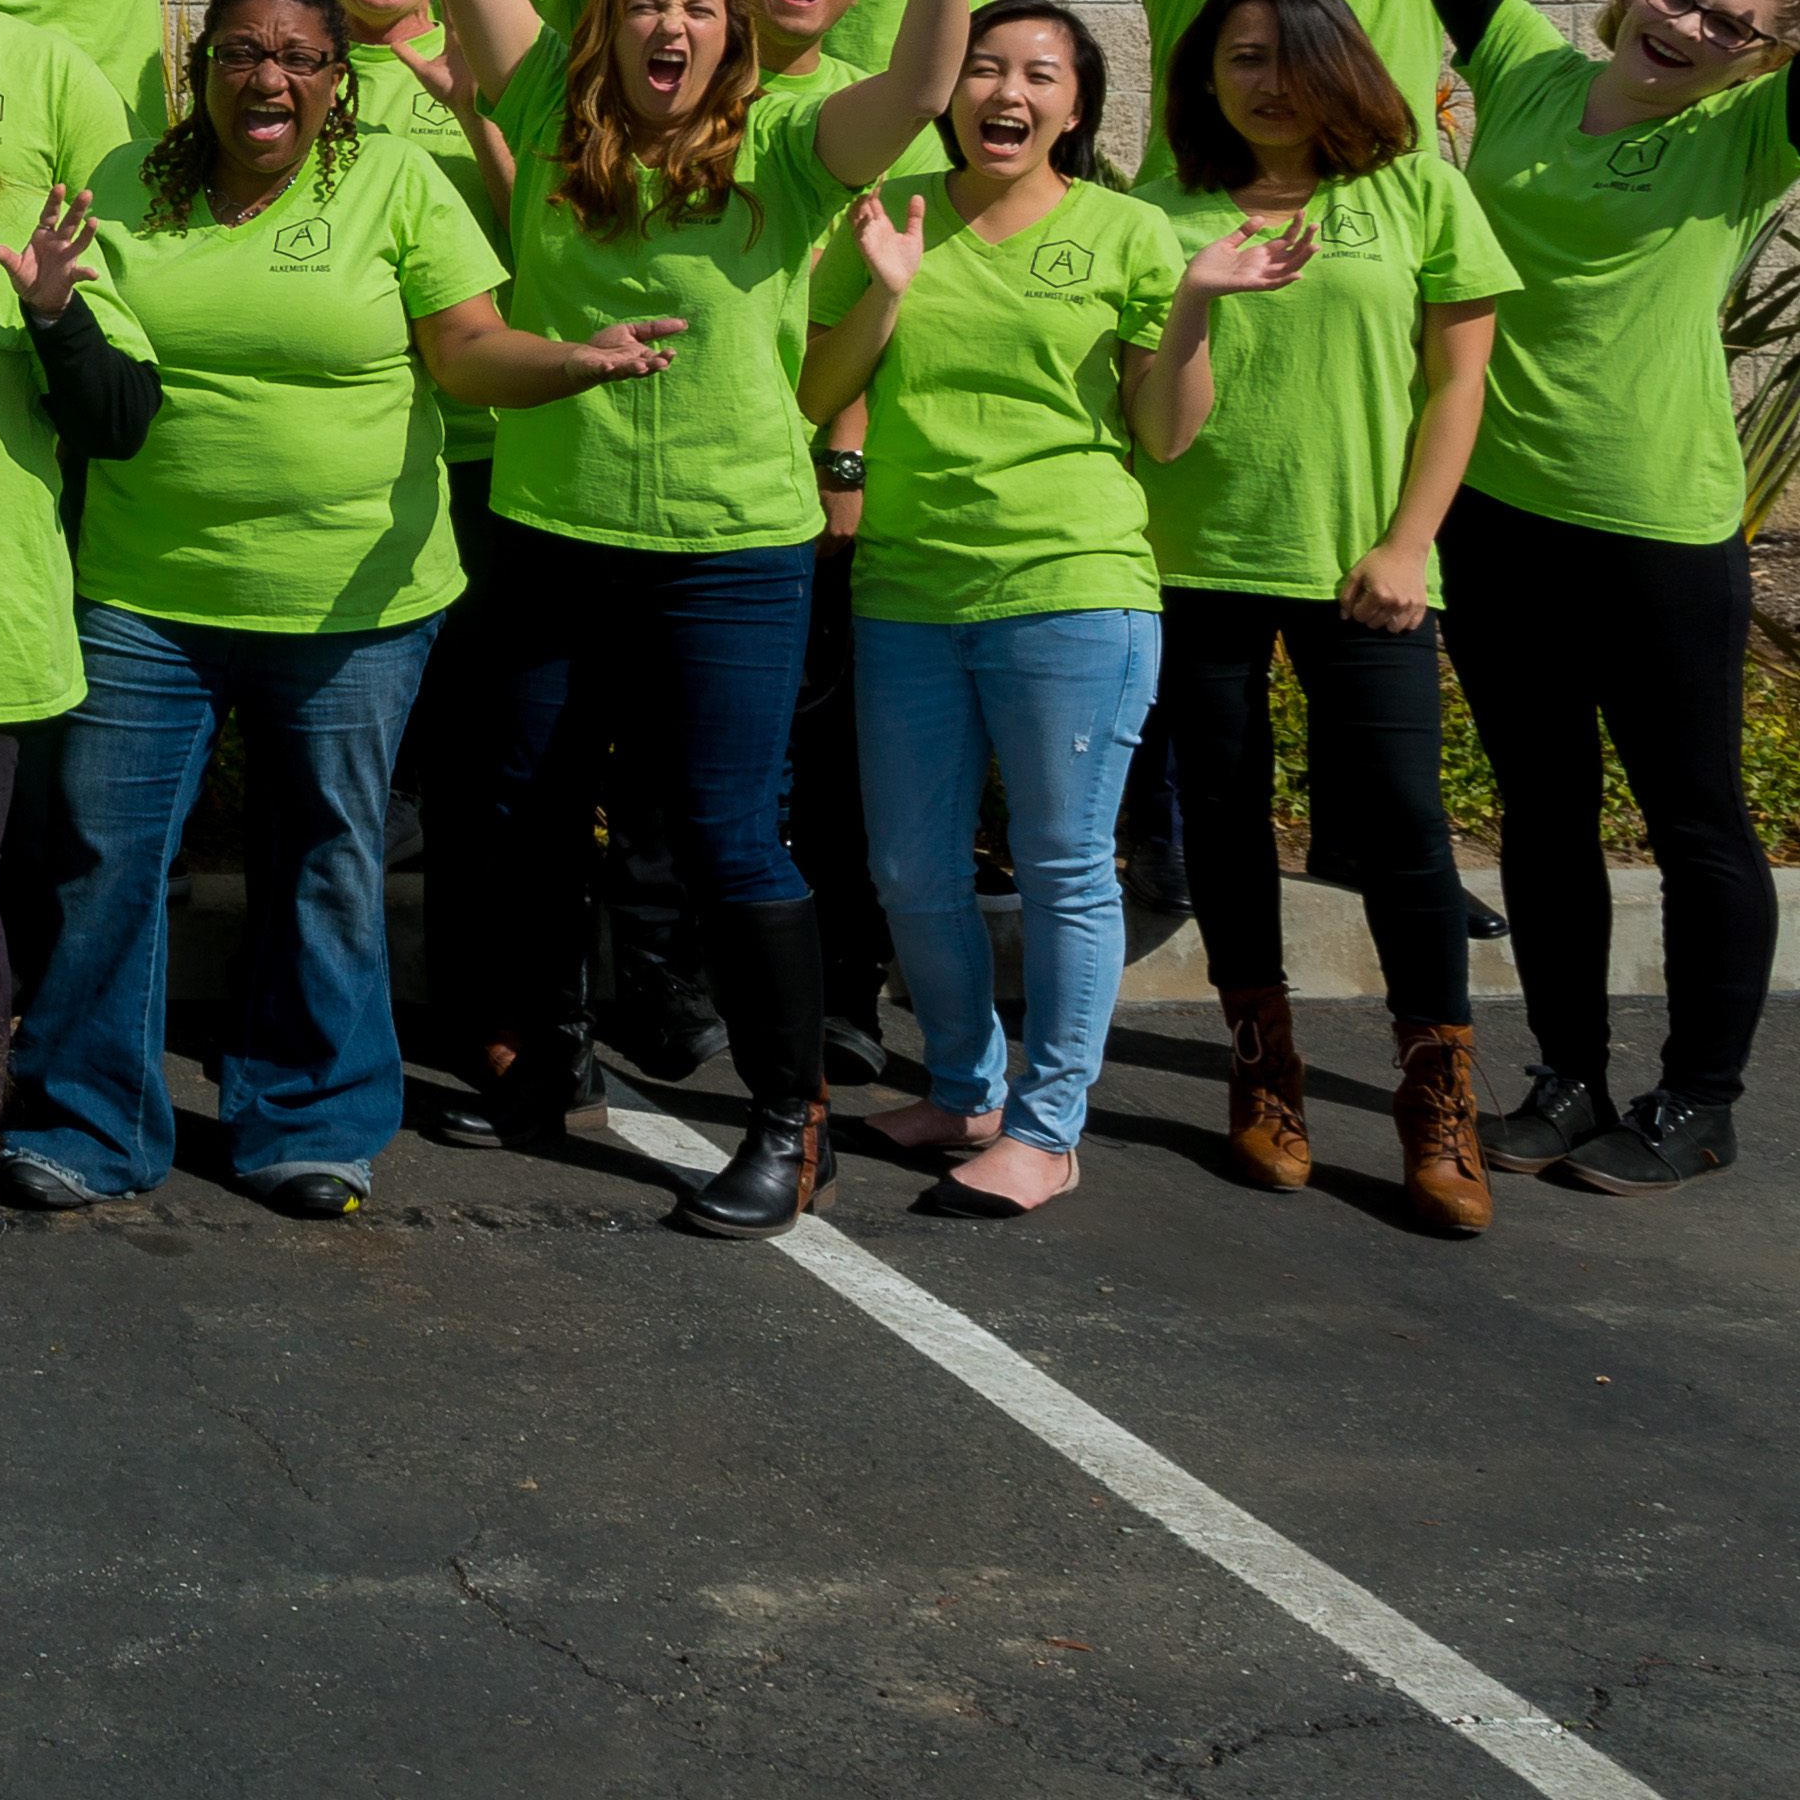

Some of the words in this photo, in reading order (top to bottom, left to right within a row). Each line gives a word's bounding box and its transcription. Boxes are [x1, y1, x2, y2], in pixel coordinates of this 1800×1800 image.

[410, 127, 443, 136] ALKEMIST
[445, 128, 463, 137] LABS
[1321, 250, 1361, 259] ALKEMIST
[1363, 252, 1383, 263] LABS
[269, 264, 308, 273] ALKEMIST
[310, 264, 331, 273] LABS
[1024, 289, 1063, 301] ALKEMIST
[1064, 293, 1085, 306] LABS
